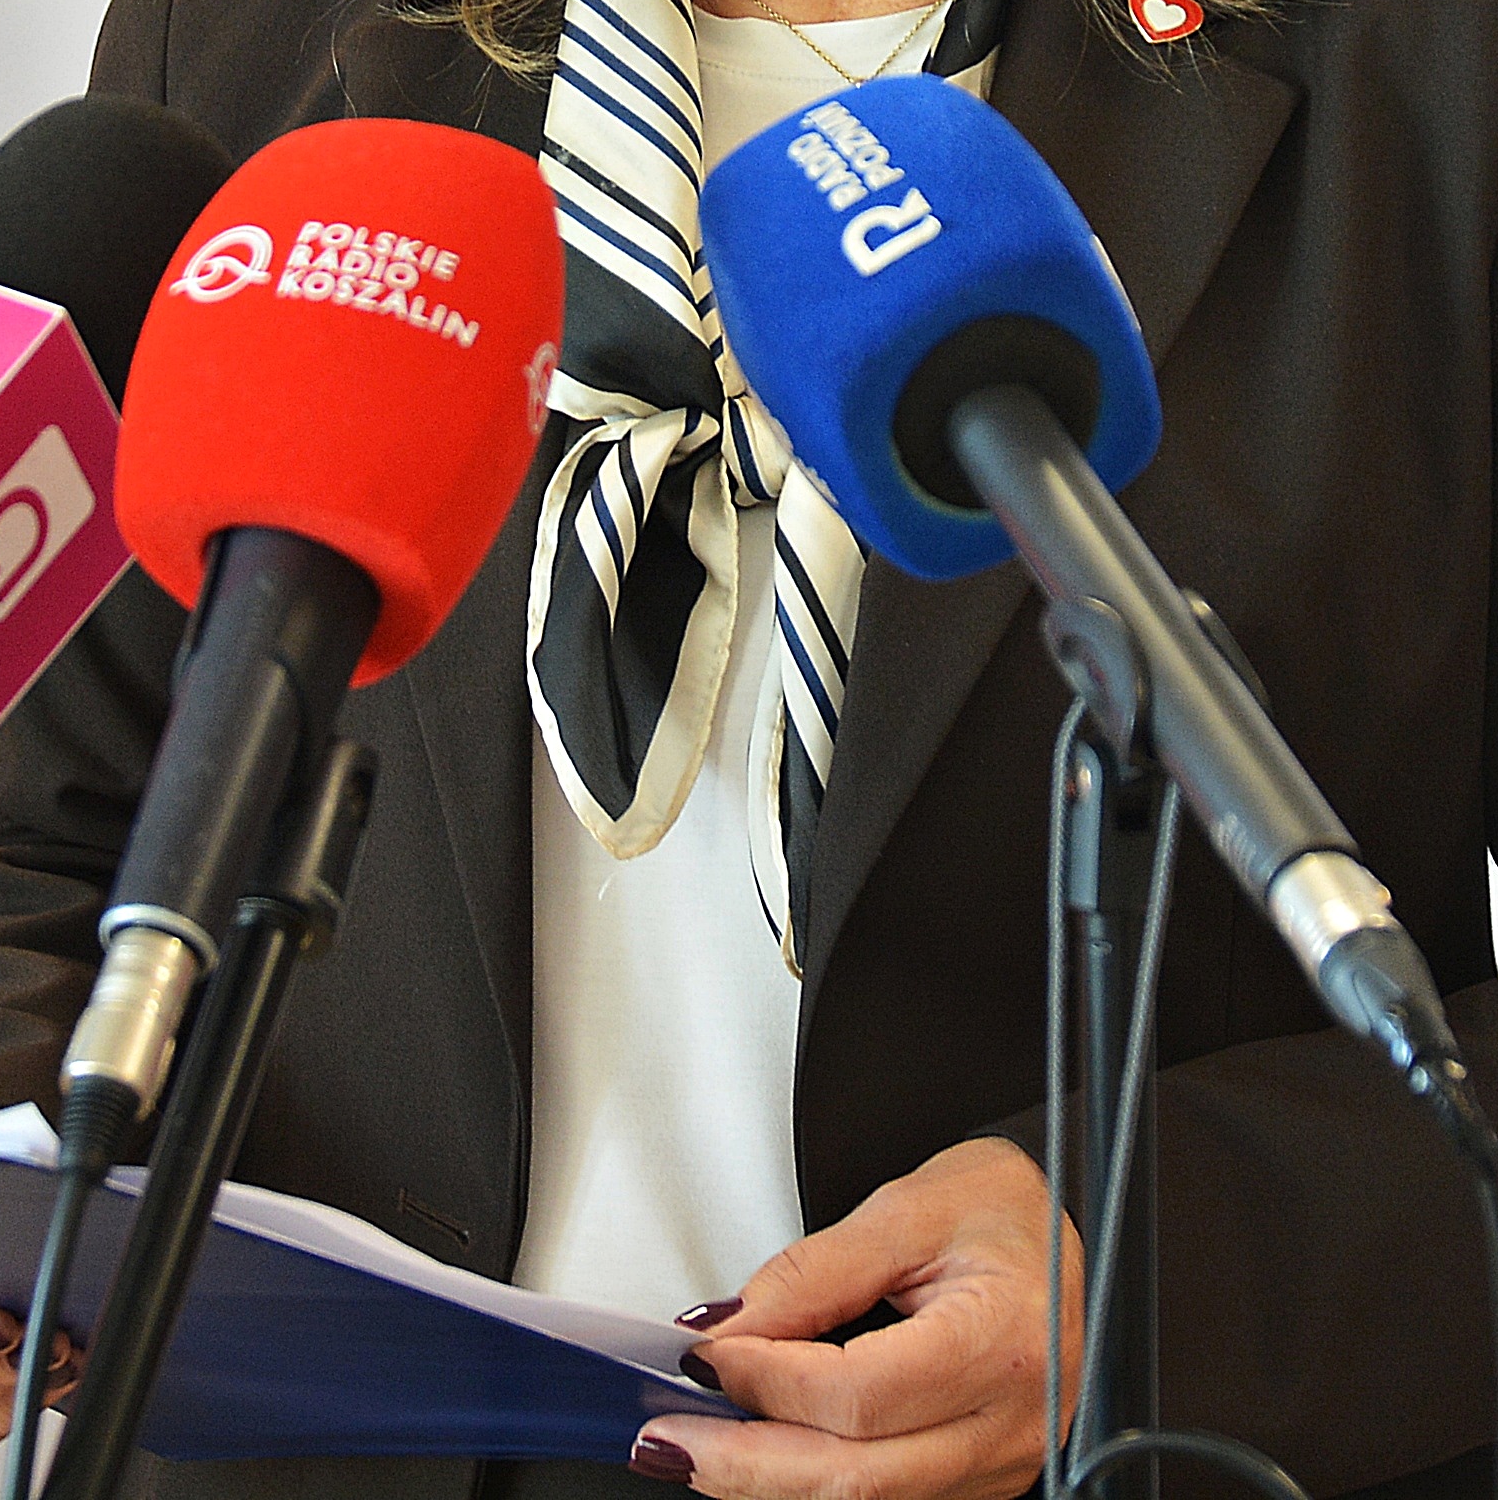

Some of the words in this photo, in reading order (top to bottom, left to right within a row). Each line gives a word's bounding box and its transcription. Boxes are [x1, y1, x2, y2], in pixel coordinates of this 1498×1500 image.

[787, 132, 868, 212] RADIO
[286, 244, 421, 291] RADIO
[296, 220, 461, 282] POLSKIE
[276, 268, 481, 348] KOSZALIN
